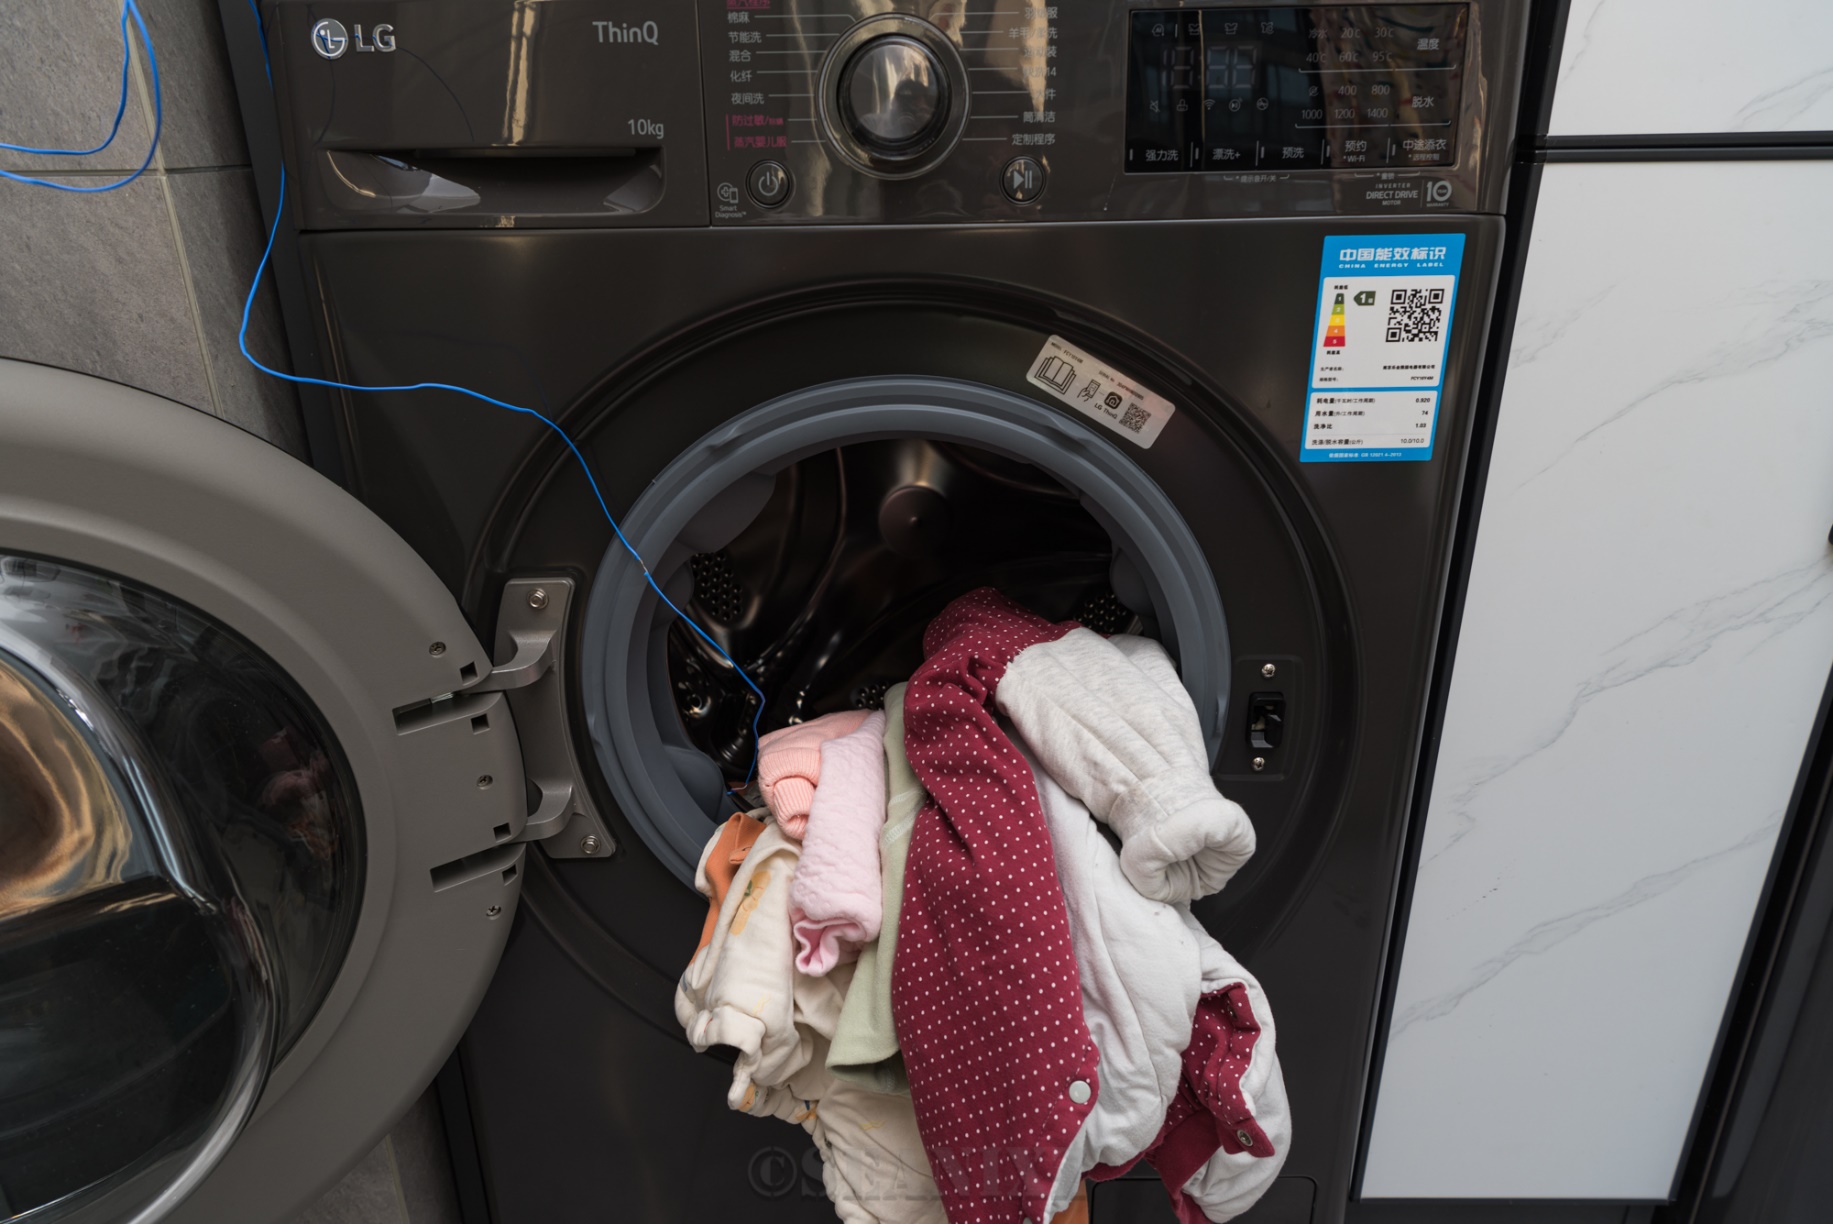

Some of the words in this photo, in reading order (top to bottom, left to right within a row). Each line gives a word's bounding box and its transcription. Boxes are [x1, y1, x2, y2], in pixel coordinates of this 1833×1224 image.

[727, 11, 750, 24] 棉麻
[354, 24, 397, 52] LG
[592, 20, 659, 45] ThinQ
[728, 31, 762, 44] 节能洗
[1416, 37, 1440, 51] 温度
[729, 49, 751, 62] 混合
[730, 69, 752, 82] 化纤
[1338, 85, 1357, 95] 400
[1371, 85, 1390, 95] 800
[731, 93, 764, 105] 夜间洗
[1411, 96, 1435, 109] 脱水
[1302, 109, 1322, 120] 1000
[1334, 109, 1355, 119] 1200
[1367, 108, 1388, 118] 1400
[628, 120, 664, 139] 10kg
[1011, 133, 1057, 146] 定制程序
[1344, 140, 1367, 152] 预约
[1402, 138, 1447, 152] 中途添衣
[1145, 149, 1178, 161] 强力洗
[1282, 147, 1304, 159] 预洗
[1365, 190, 1394, 200] DIRECT
[1395, 190, 1418, 199] DRIVE
[1426, 180, 1453, 202] 10
[1339, 247, 1447, 262] 中国能效标识
